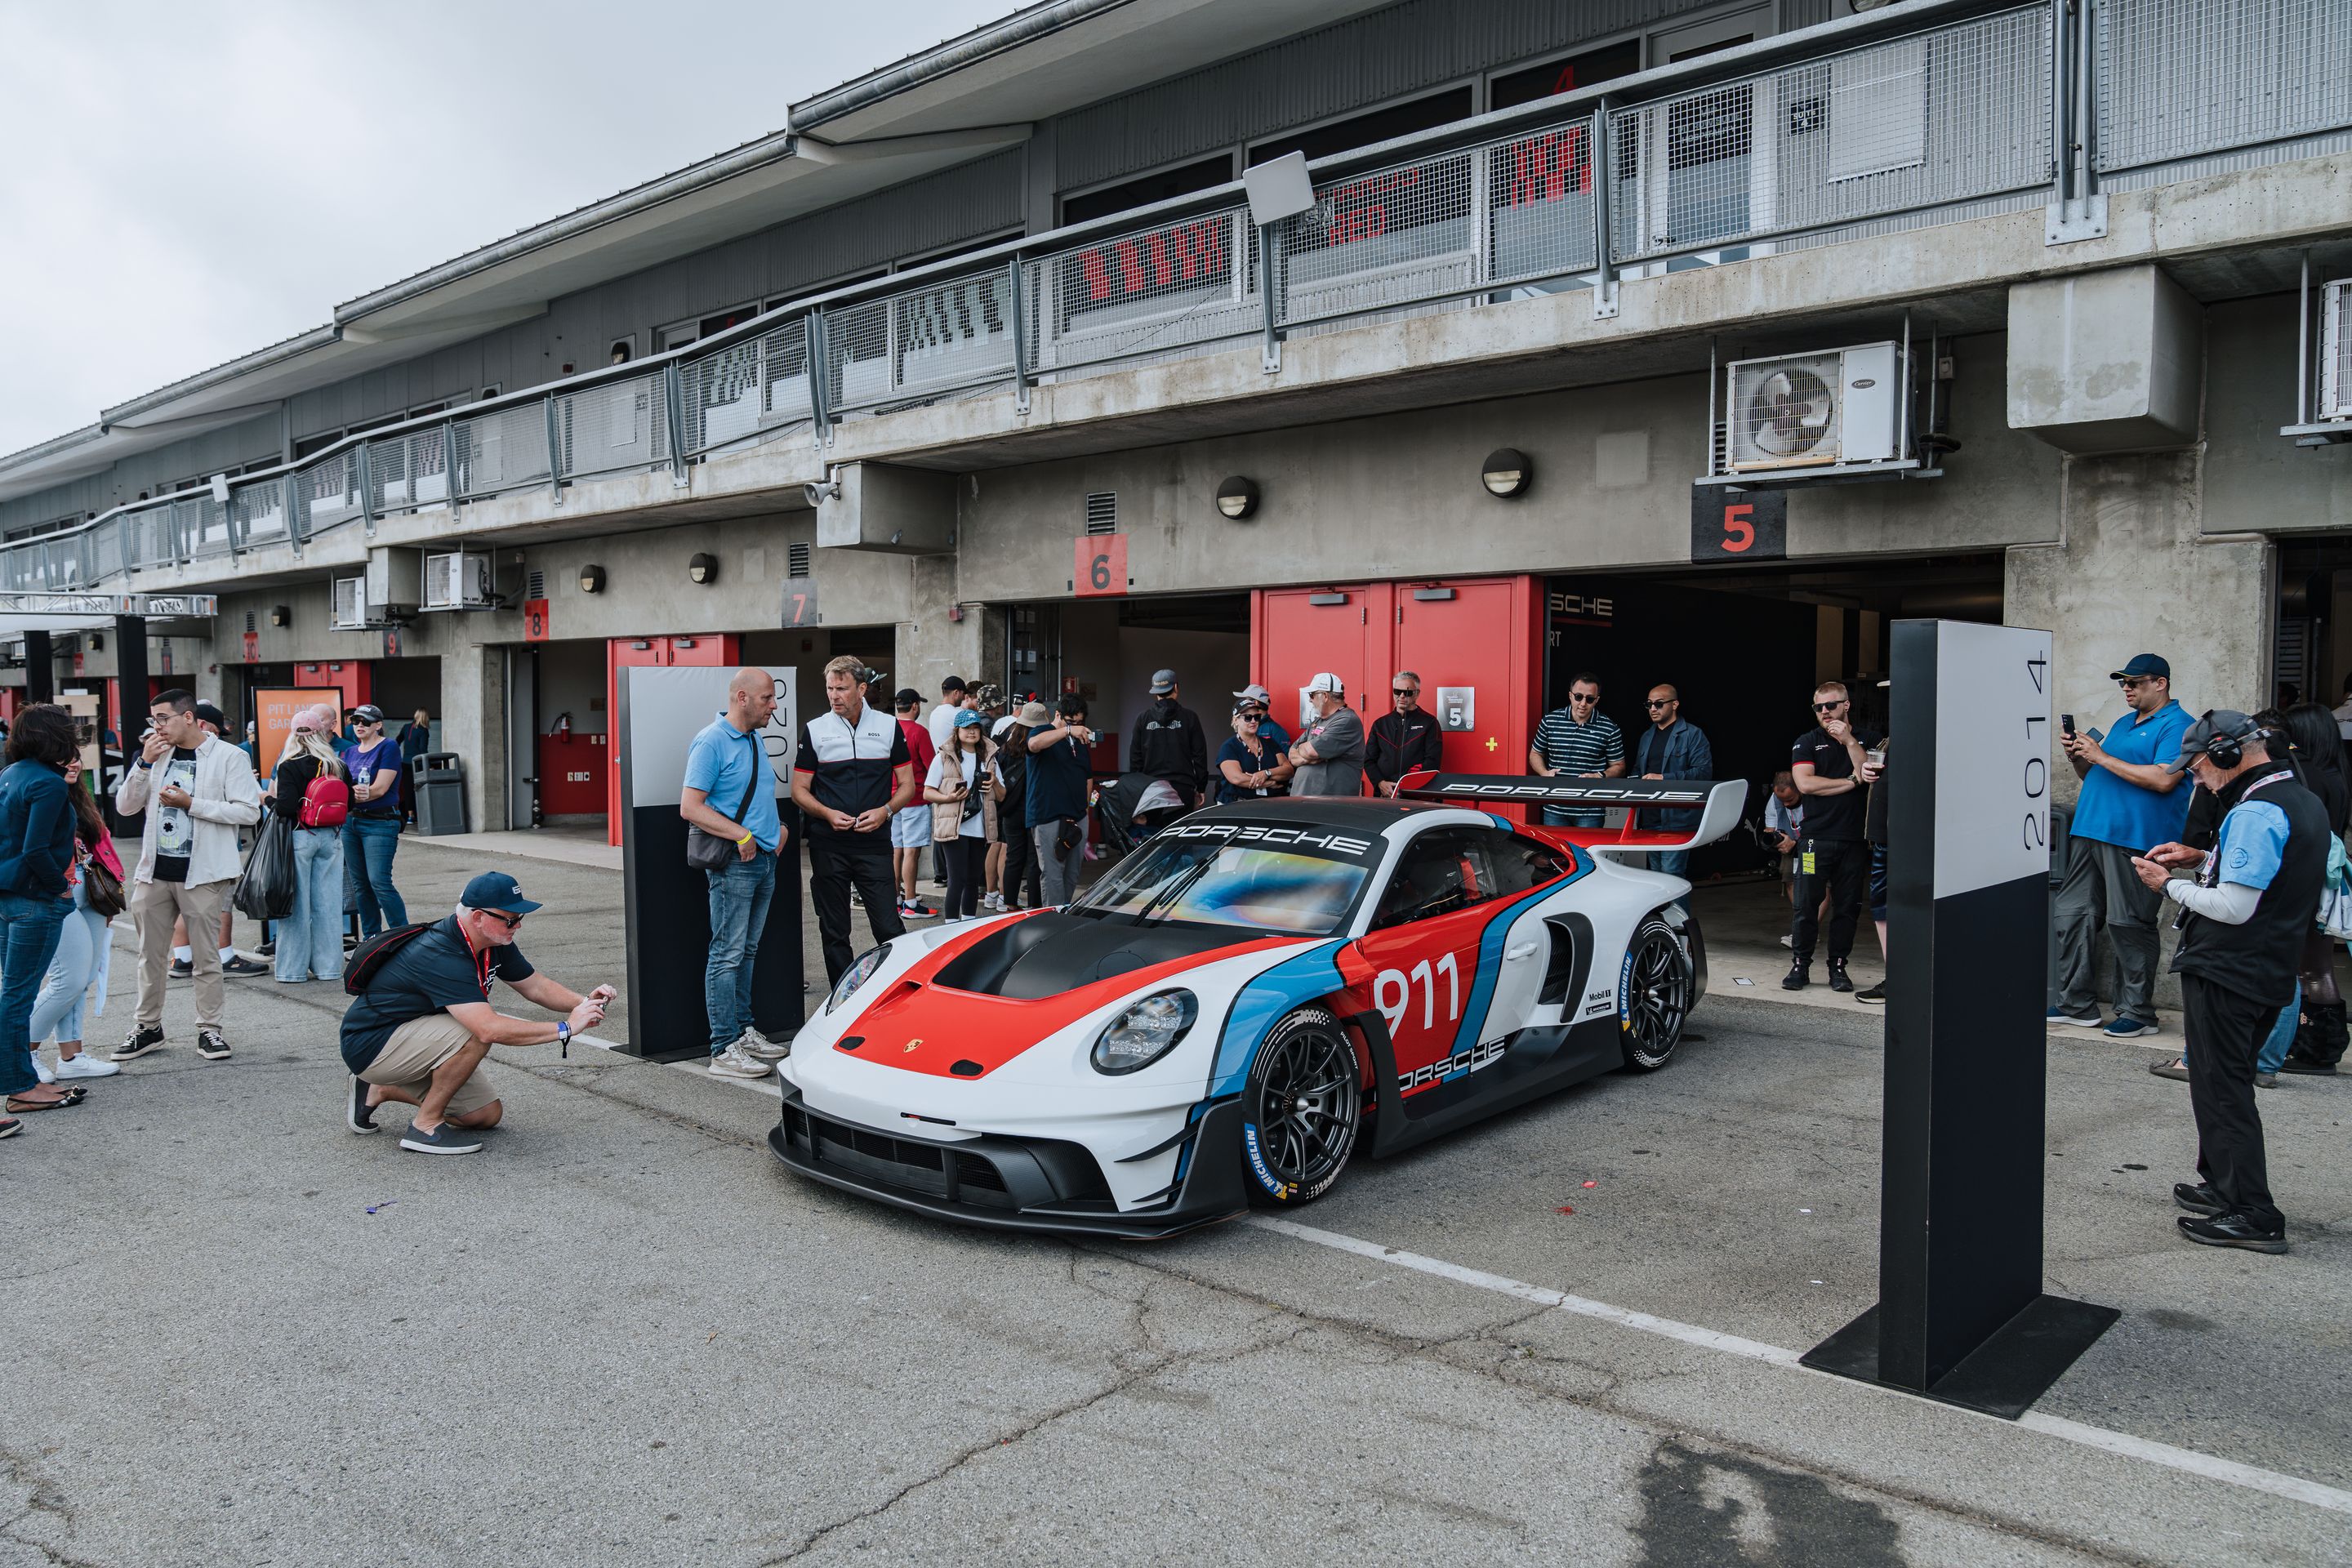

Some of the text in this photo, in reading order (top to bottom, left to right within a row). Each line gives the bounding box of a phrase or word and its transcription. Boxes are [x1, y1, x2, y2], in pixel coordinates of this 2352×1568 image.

[1793, 109, 1816, 120] SUITE
[1330, 204, 1386, 247] RED
[1721, 504, 1755, 552] 5
[1091, 555, 1111, 590] 6
[792, 594, 806, 624] 7
[1551, 593, 1613, 617] SCHE
[532, 612, 542, 636] 8
[246, 642, 257, 660] 10
[388, 633, 396, 655] 9
[269, 703, 314, 715] PIT LAN
[1449, 707, 1462, 726] 5
[269, 718, 292, 729] GAR
[2024, 650, 2047, 850] 2014
[1441, 783, 1704, 801] PORSCHE
[1155, 825, 1371, 857] PORSCHE
[1621, 956, 1633, 1010] MICHELIN
[1374, 951, 1459, 1040] 911
[1589, 990, 1606, 1001] Mobil
[1340, 1031, 1352, 1048] PILOT
[1349, 1048, 1359, 1070] SPORT
[1397, 1036, 1505, 1093] ORSCHE
[1247, 1129, 1276, 1188] MICHELIN
